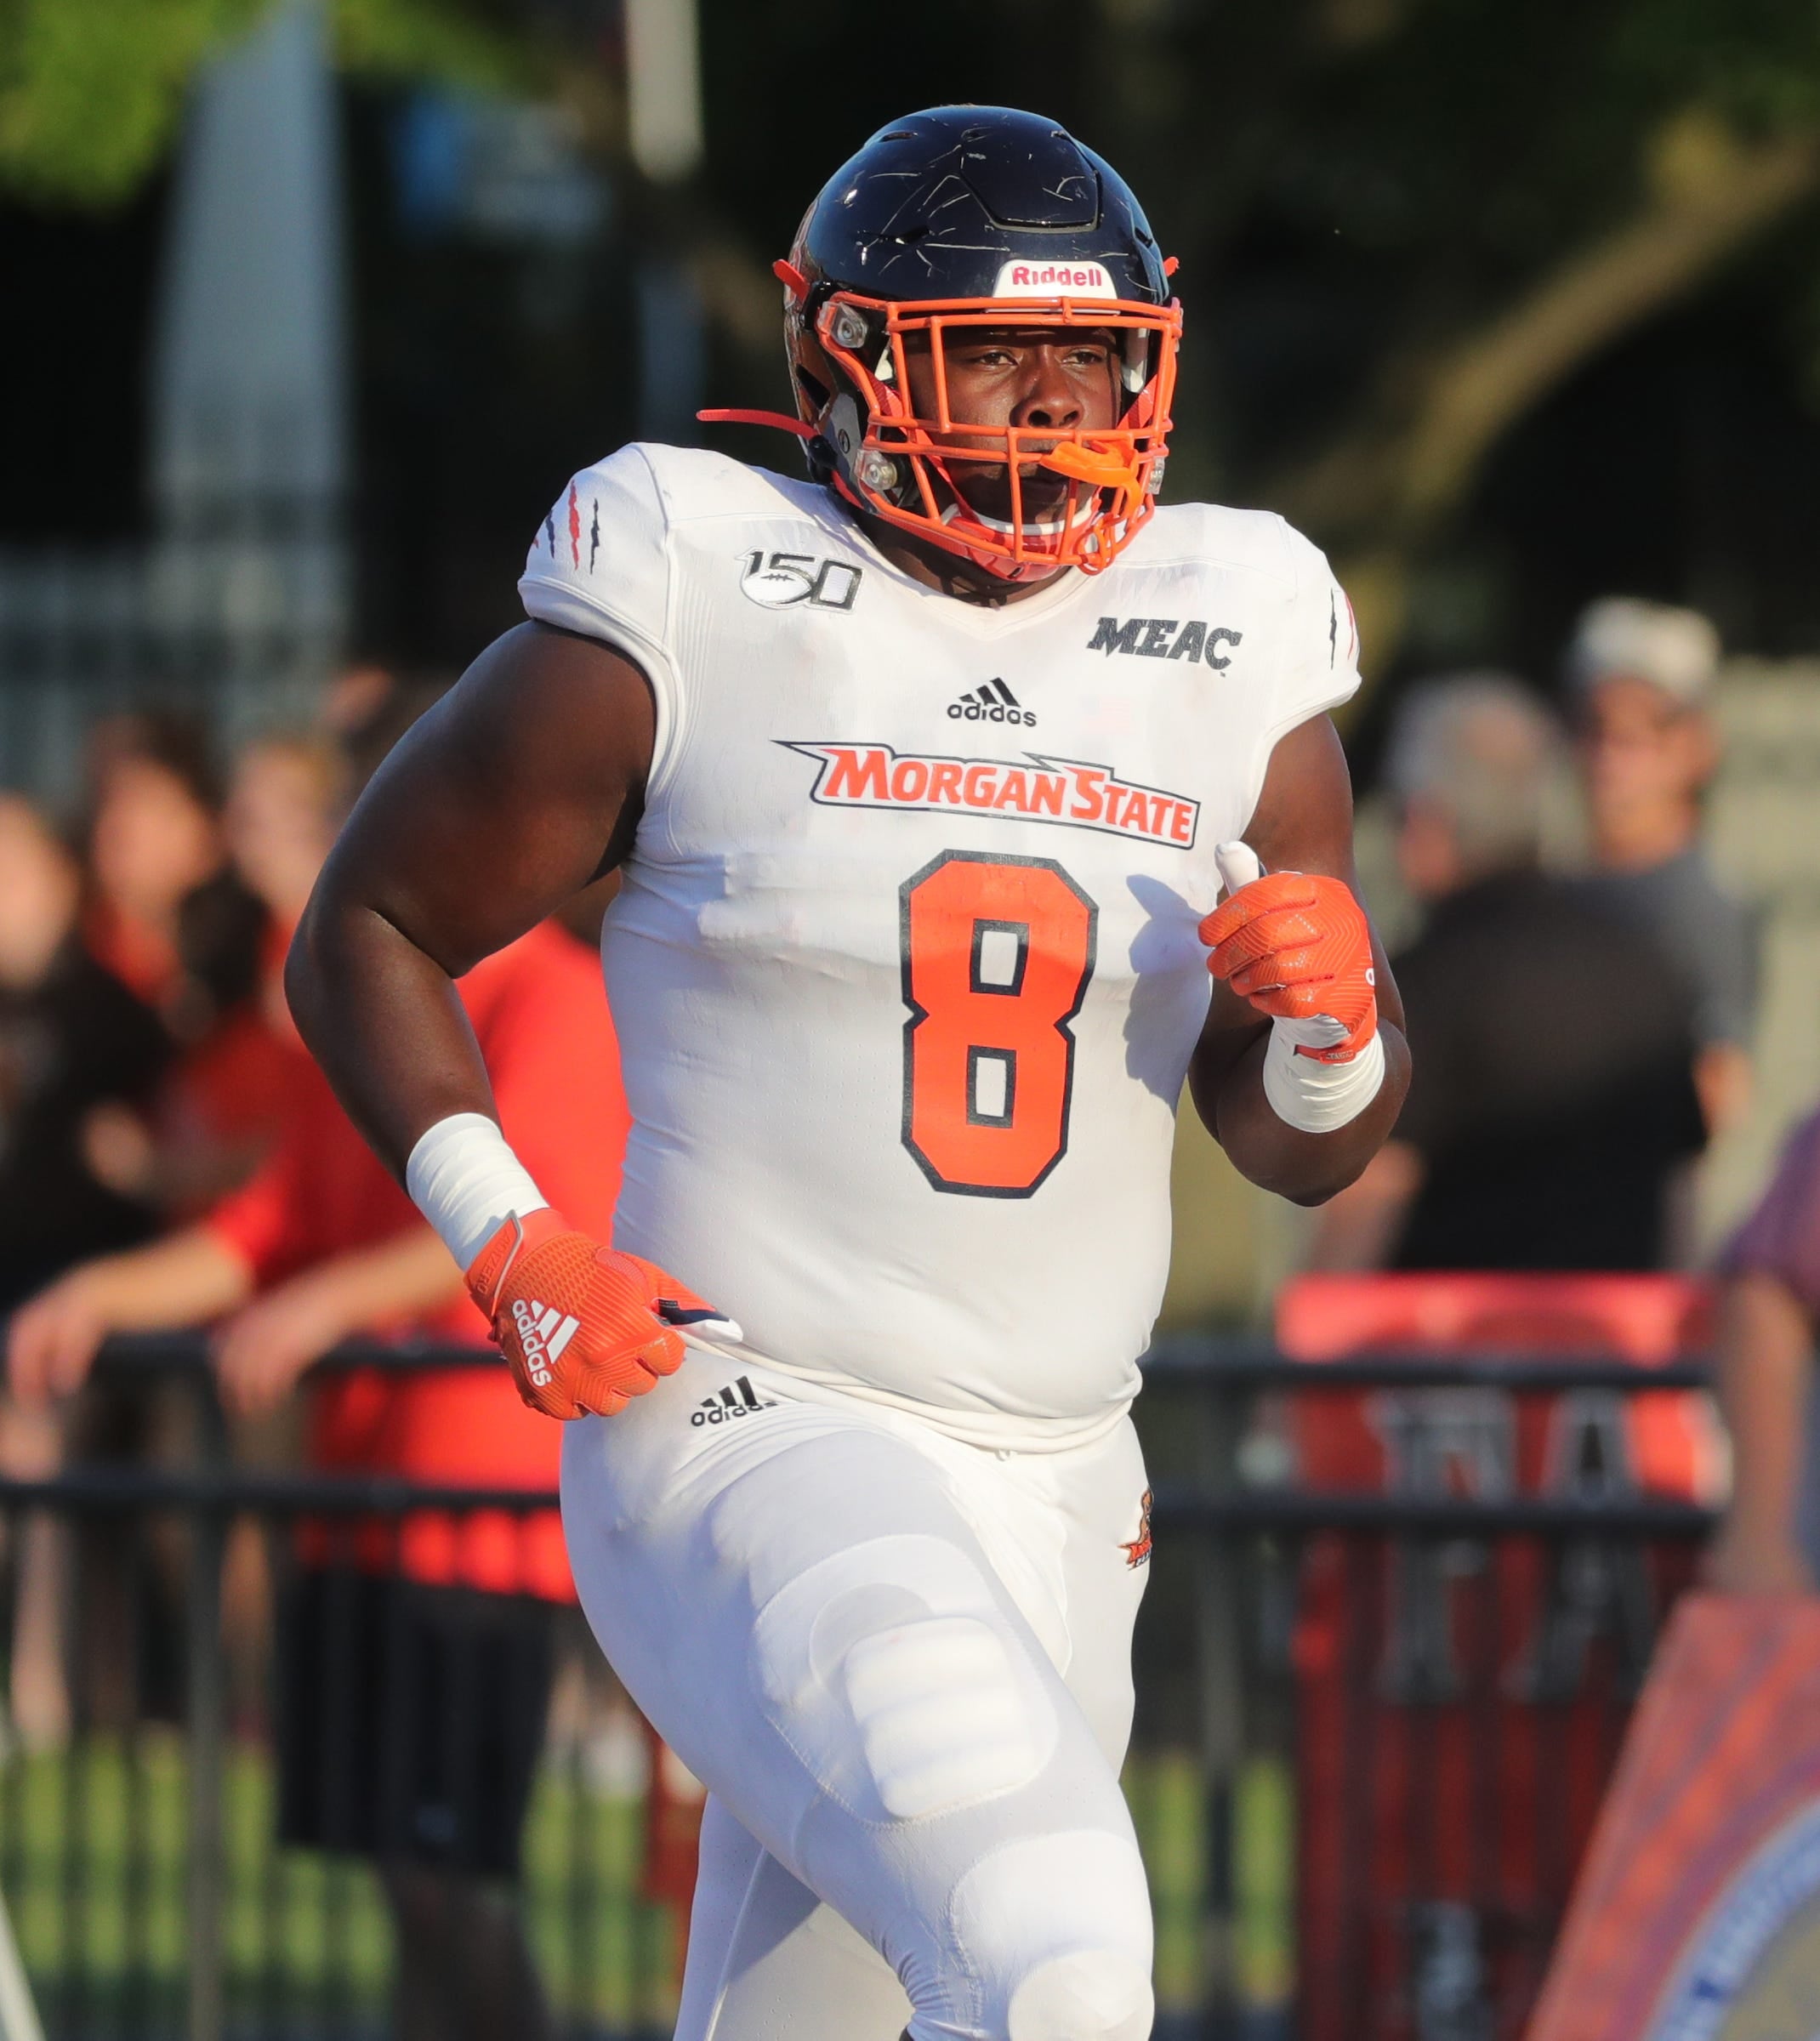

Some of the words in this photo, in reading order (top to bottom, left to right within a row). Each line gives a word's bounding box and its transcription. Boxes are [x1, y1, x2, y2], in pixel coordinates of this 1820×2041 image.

[1012, 266, 1102, 287] Riddell
[742, 550, 863, 611] 150
[1086, 617, 1243, 670] MEAC
[947, 702, 1037, 727] adidas
[898, 848, 1100, 1199] 8
[512, 1299, 552, 1387] adidas
[691, 1401, 778, 1427] adidas
